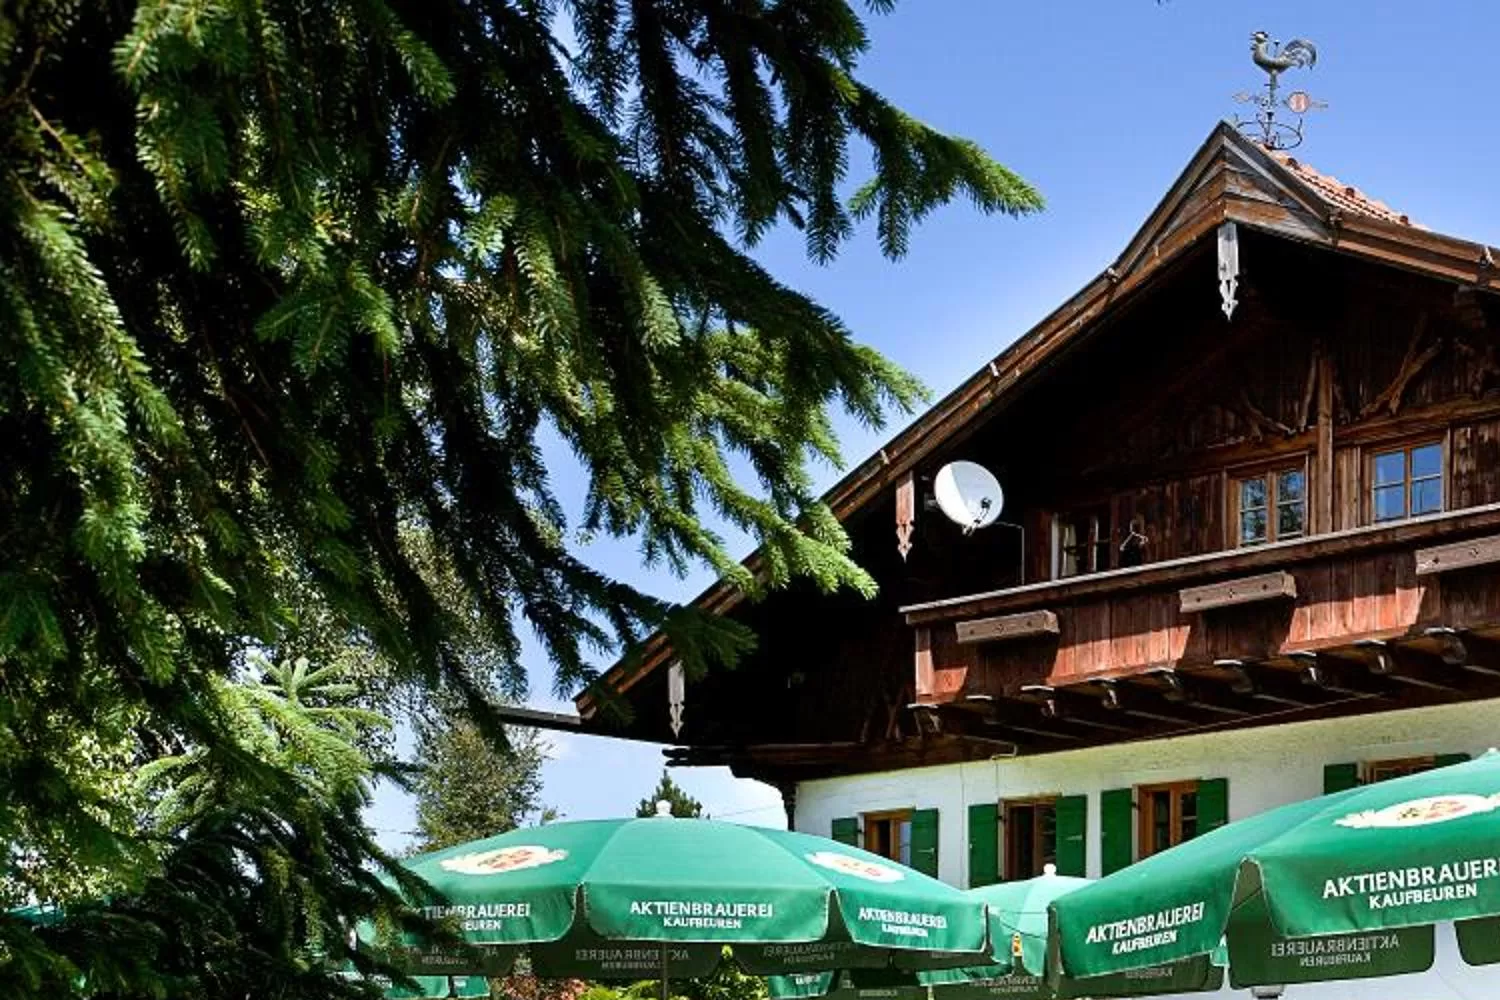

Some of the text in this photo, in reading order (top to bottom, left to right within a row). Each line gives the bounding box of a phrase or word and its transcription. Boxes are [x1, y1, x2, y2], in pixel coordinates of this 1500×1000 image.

[1369, 883, 1478, 909] KAUFBEUREN
[630, 901, 774, 918] AKTIENBRAUEREI
[663, 917, 742, 929] KAUFBEUREN
[1086, 901, 1206, 944] AKTIENBRAUEREI
[1111, 931, 1178, 955] KAUFBEUREN
